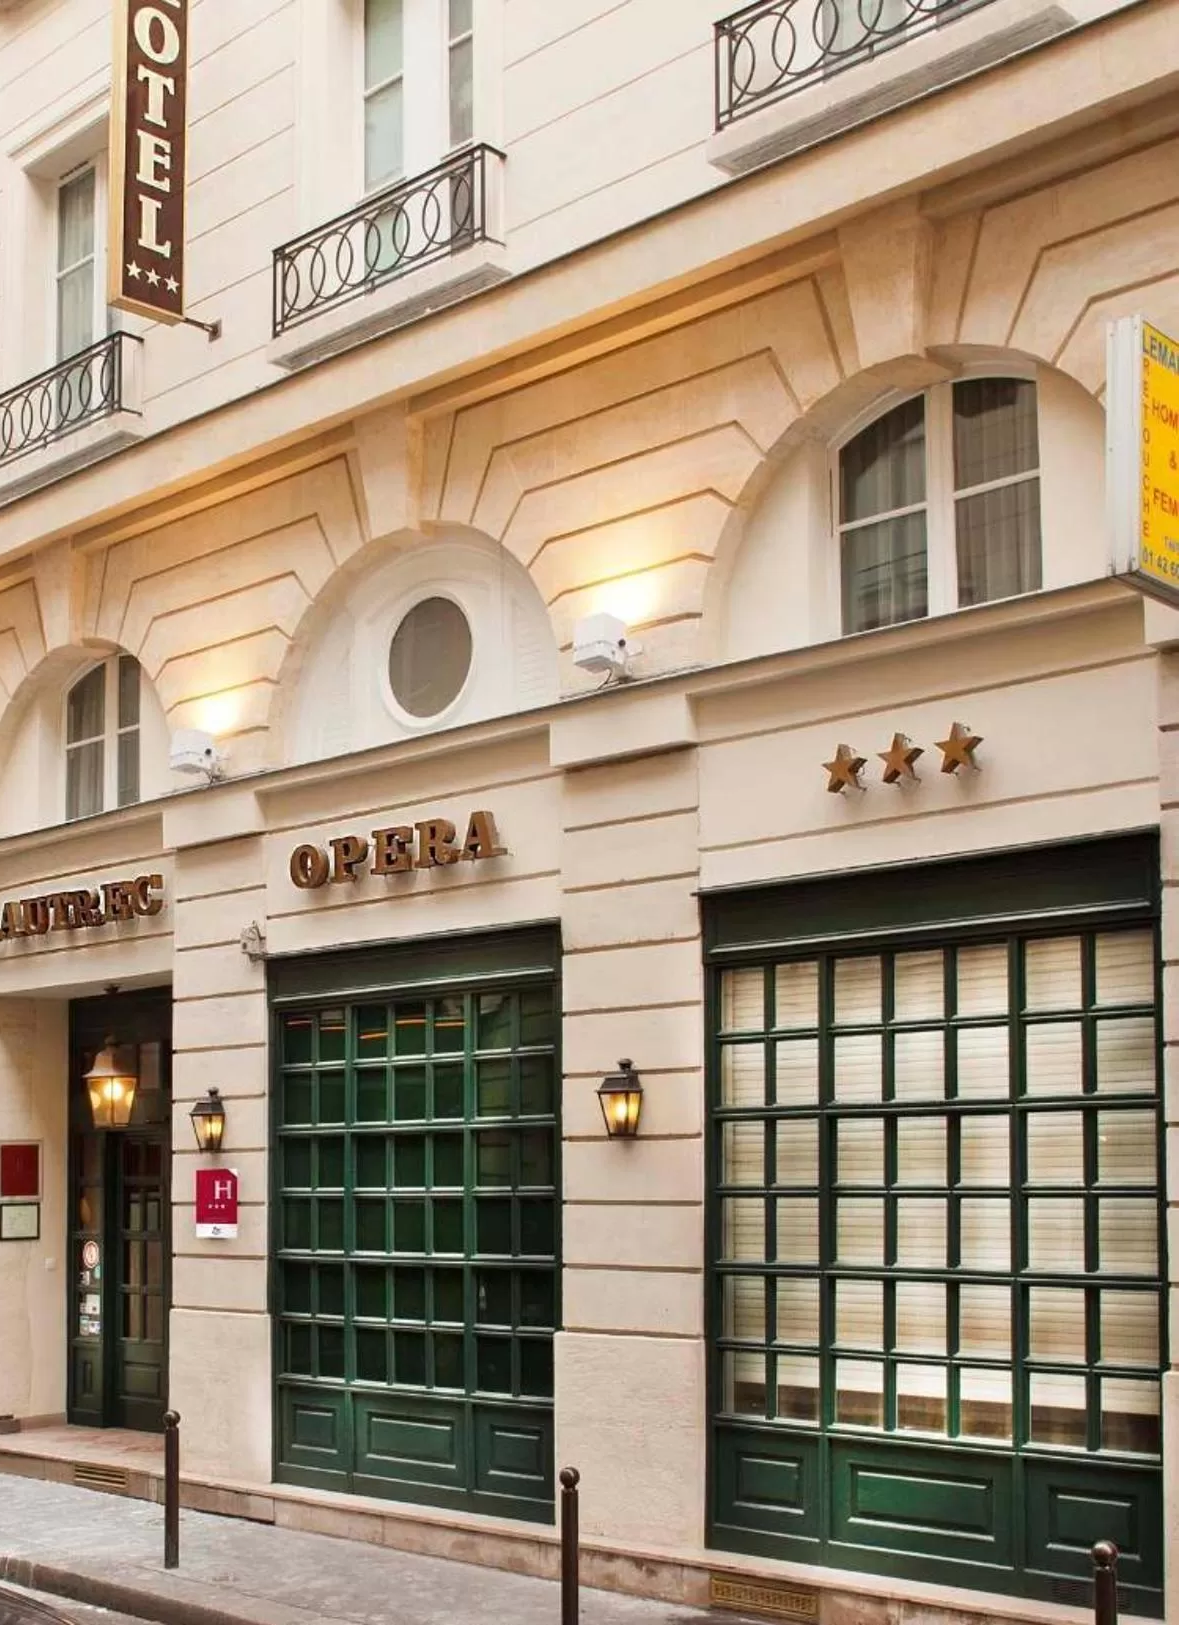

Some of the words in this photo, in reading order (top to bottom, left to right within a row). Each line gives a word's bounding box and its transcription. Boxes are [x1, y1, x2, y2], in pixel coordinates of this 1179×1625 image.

[133, 0, 181, 259] OTEL
[1142, 327, 1179, 377] LEMA
[290, 811, 509, 889] OPERA
[214, 1180, 232, 1199] H
